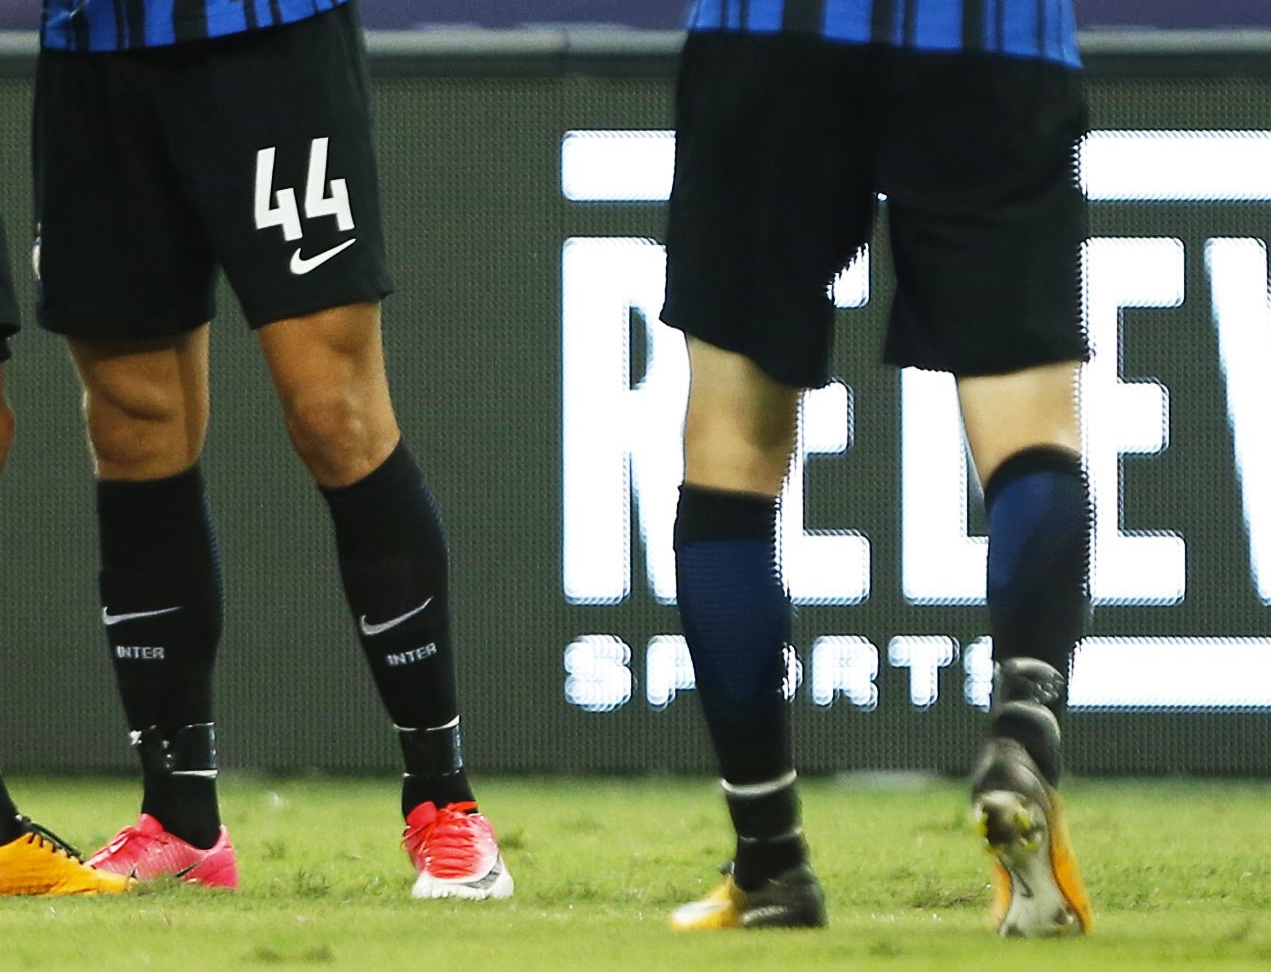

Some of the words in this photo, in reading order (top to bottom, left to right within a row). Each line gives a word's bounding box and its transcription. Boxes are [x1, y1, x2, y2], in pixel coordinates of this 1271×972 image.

[254, 137, 355, 242] 44
[115, 644, 166, 660] INTER
[387, 641, 437, 666] INTER
[563, 634, 995, 712] SPRT
